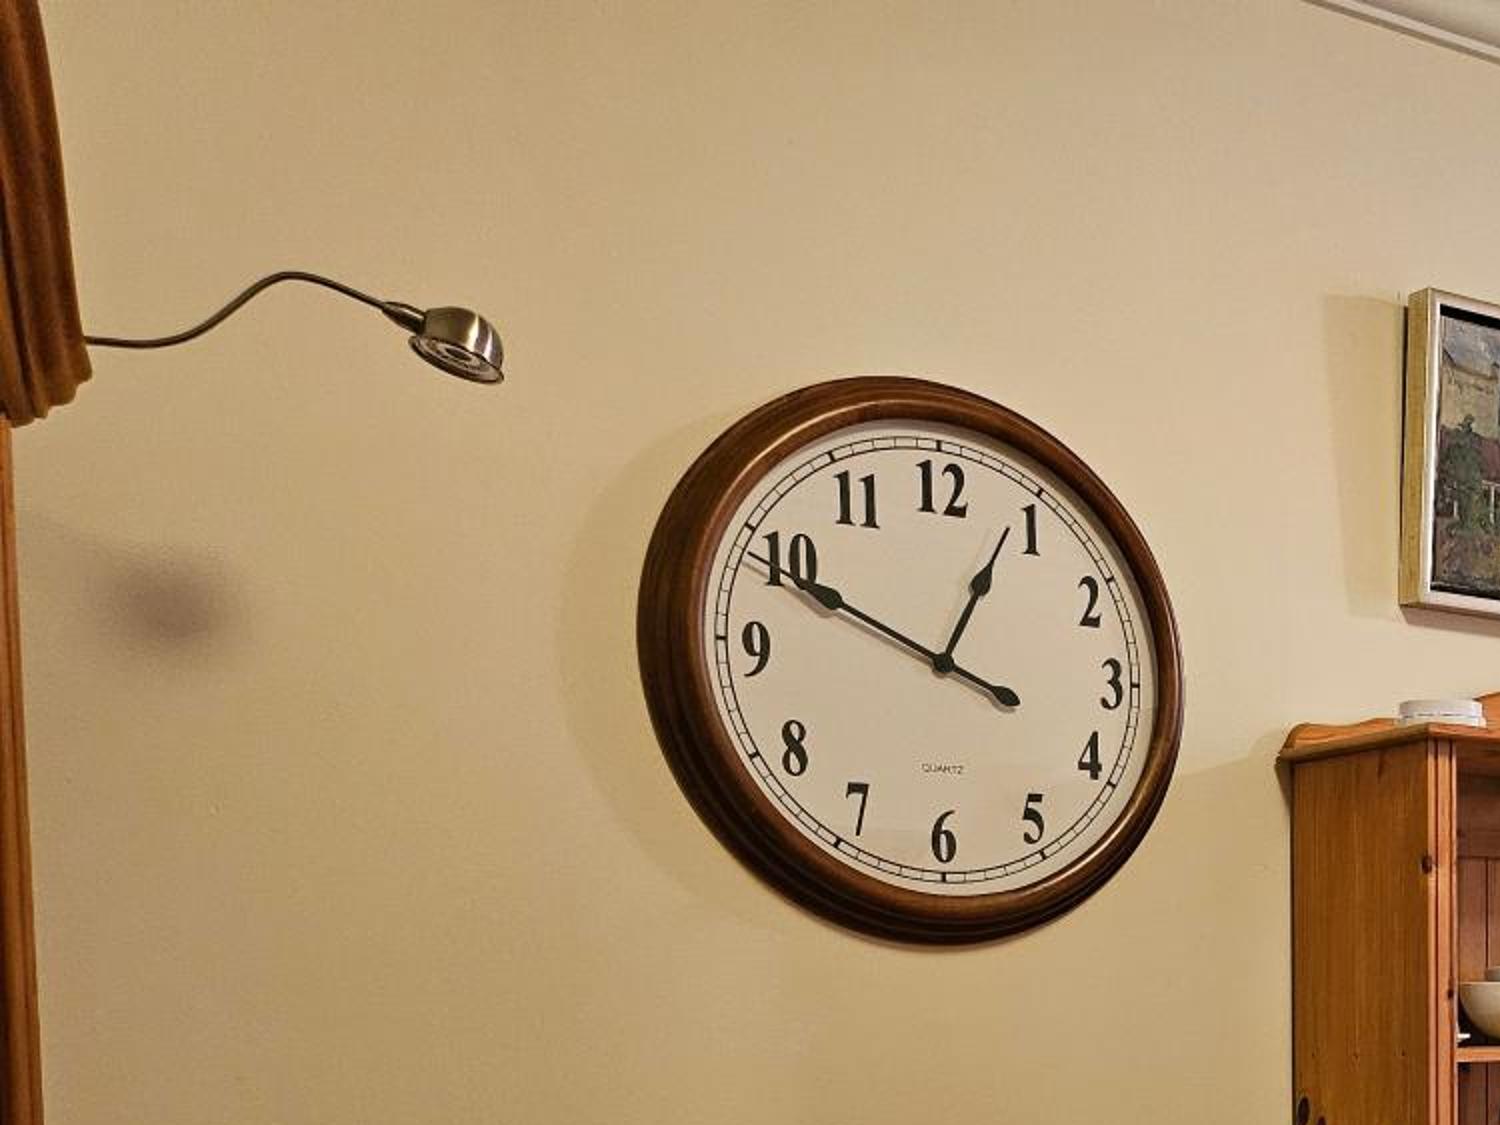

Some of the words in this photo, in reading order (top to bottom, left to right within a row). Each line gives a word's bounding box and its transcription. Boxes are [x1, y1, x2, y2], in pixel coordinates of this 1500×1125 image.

[834, 470, 880, 528] 11
[915, 459, 968, 518] 12
[1021, 503, 1041, 556] 1
[763, 531, 818, 588] 10
[1078, 575, 1101, 628] 2
[741, 621, 771, 677] 9
[1100, 657, 1124, 710] 3
[781, 719, 808, 776] 8
[920, 763, 965, 775] QUARTZ
[1077, 731, 1103, 780] 4
[845, 782, 870, 836] 7
[1022, 793, 1045, 844] 5
[931, 810, 957, 863] 6
